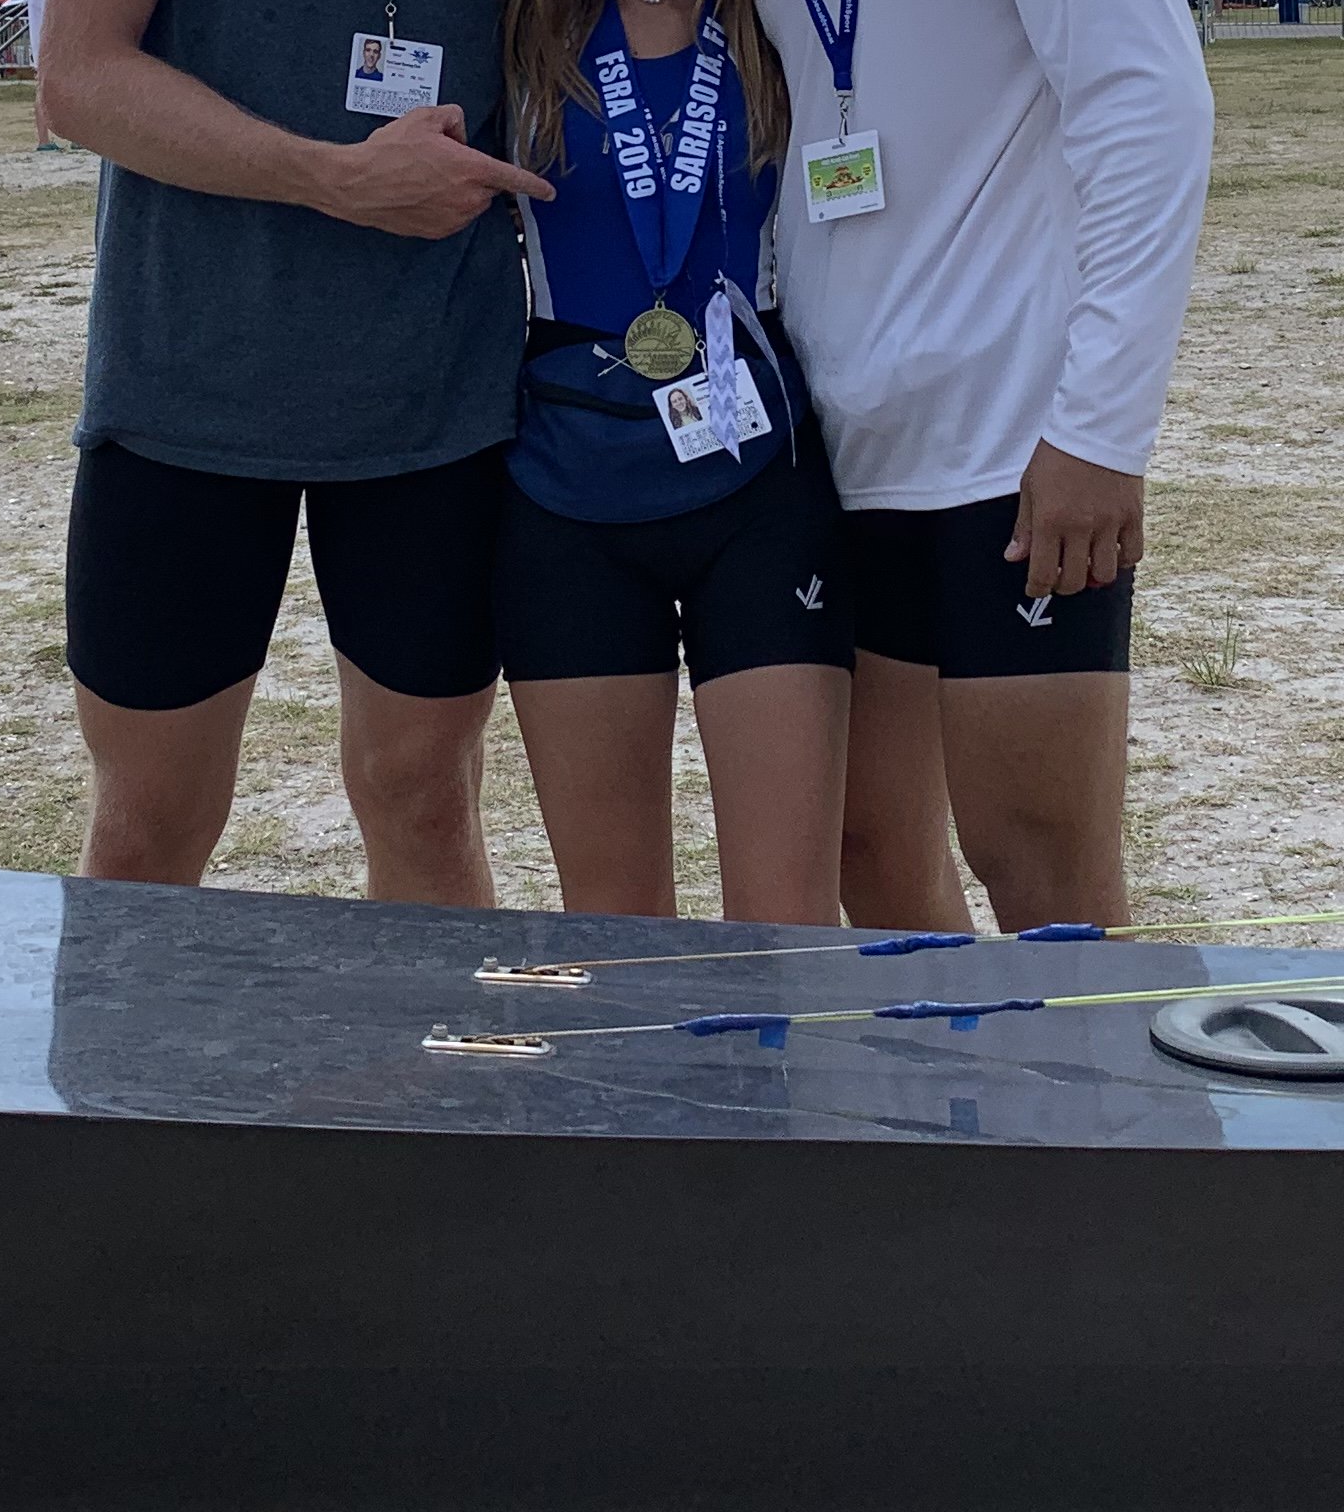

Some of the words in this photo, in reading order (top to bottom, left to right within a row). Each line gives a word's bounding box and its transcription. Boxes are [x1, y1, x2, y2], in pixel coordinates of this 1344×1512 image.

[595, 50, 637, 119] FSRA
[670, 53, 726, 194] SARASOTA,
[612, 127, 657, 200] 2019
